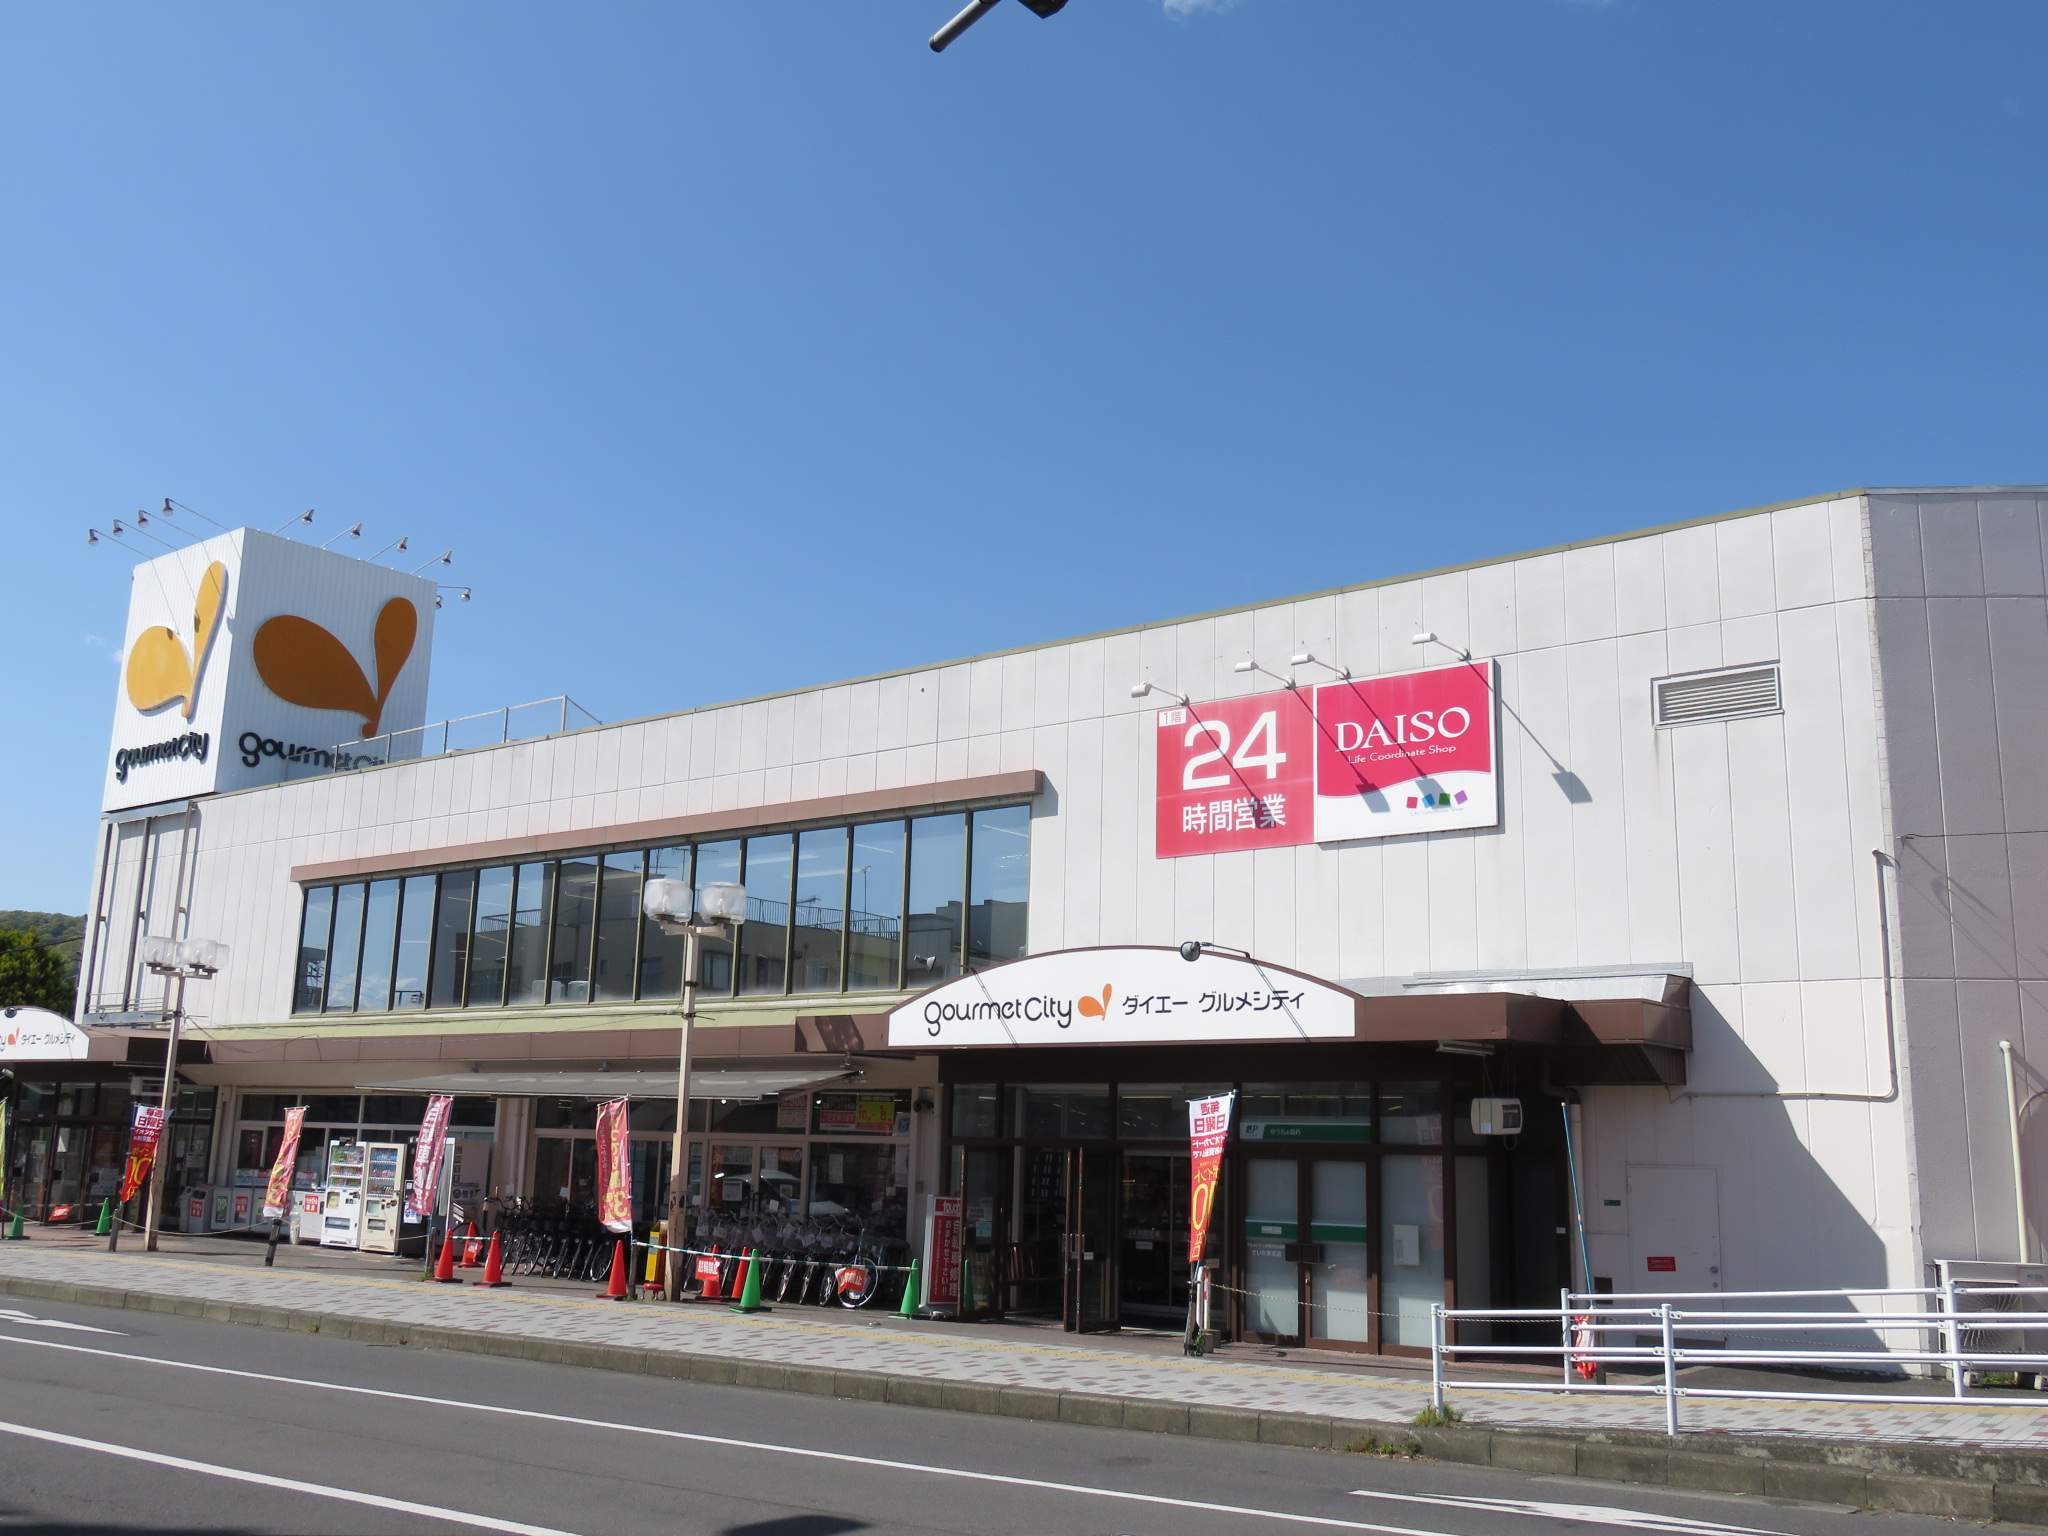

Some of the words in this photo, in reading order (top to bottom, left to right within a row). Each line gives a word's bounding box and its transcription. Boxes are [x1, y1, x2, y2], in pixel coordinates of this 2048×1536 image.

[1163, 711, 1182, 725] 1階
[1334, 706, 1471, 752] DAISO
[1182, 710, 1287, 791] 24
[1347, 754, 1367, 765] Life
[1369, 748, 1426, 762] Coordinate
[1428, 744, 1457, 757] Shop
[1182, 793, 1287, 835] 時間営業
[1122, 995, 1189, 1015] ダイエー
[1198, 990, 1306, 1013] グルメシティ
[21, 1034, 42, 1046] ダイエー
[44, 1032, 77, 1045] グルメシティ
